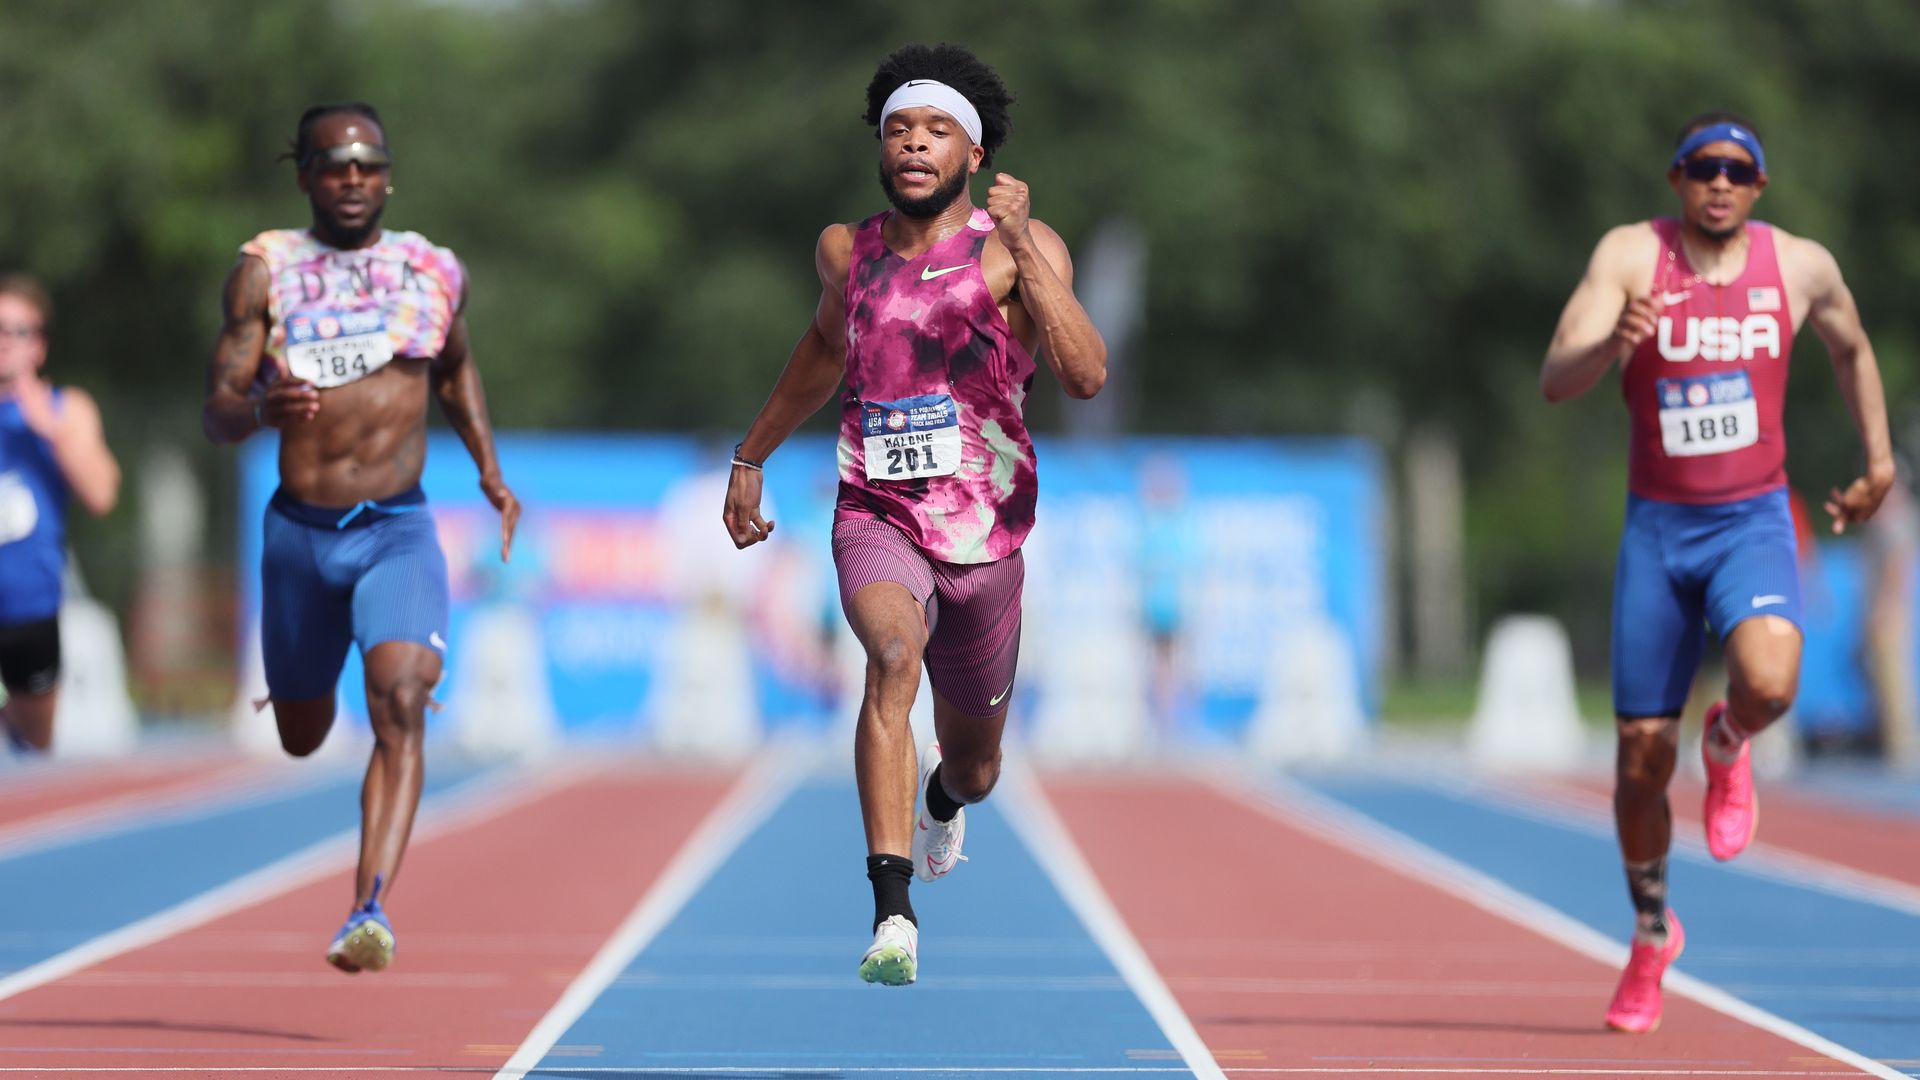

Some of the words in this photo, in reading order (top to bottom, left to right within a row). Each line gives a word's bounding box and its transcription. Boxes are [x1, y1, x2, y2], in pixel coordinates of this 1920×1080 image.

[1657, 313, 1780, 362] USA
[316, 353, 368, 379] 184
[868, 417, 882, 428] USA
[927, 409, 948, 420] TRIALS
[884, 433, 933, 448] MALONE
[1682, 415, 1738, 443] 188
[886, 444, 938, 475] 201
